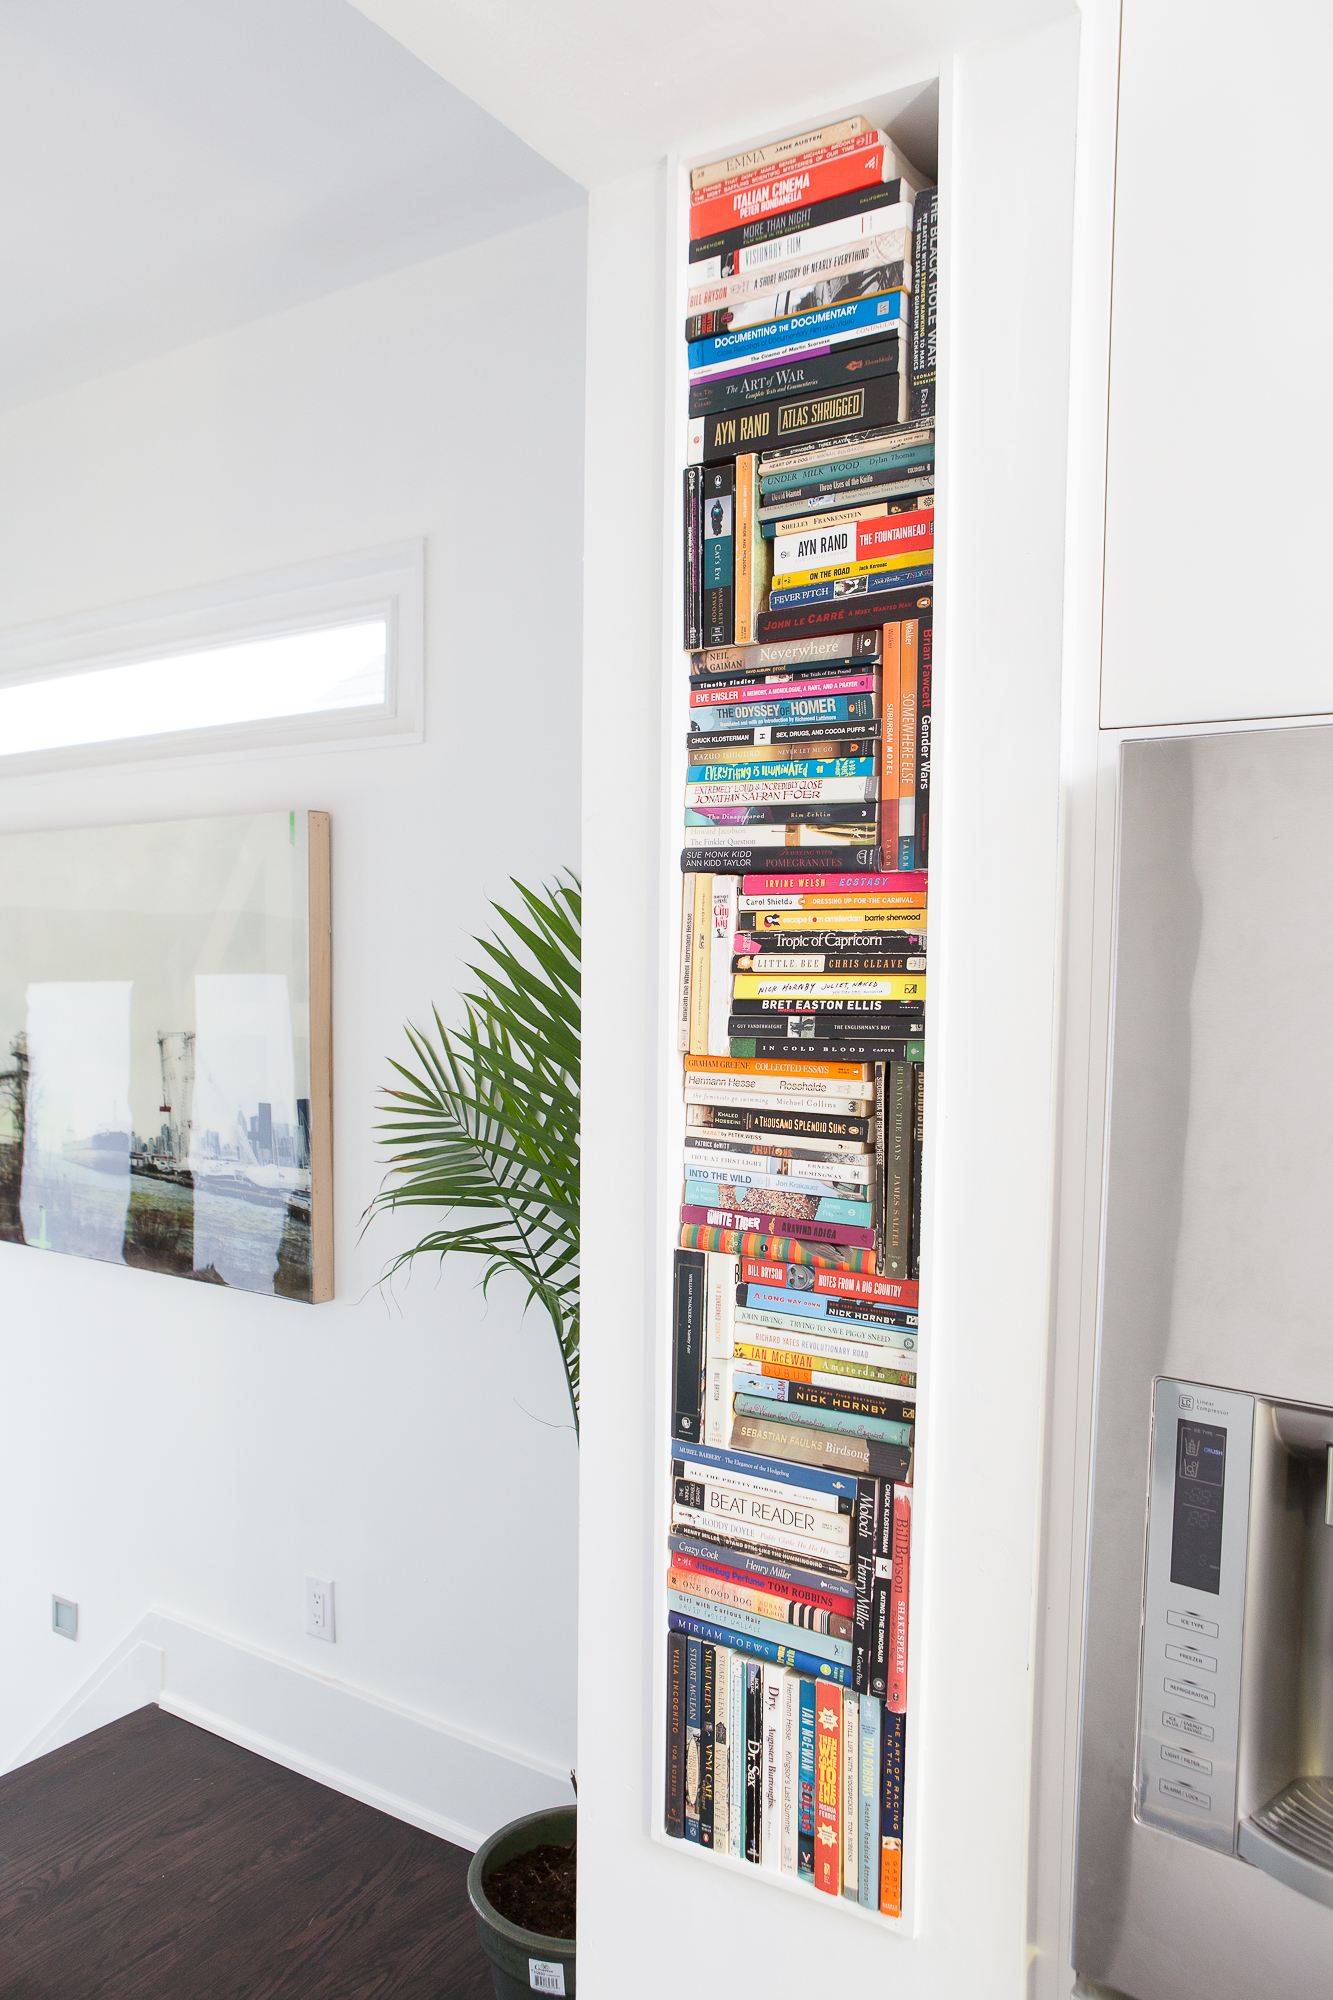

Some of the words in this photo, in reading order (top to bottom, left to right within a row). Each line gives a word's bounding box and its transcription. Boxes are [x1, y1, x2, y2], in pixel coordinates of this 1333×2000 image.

[726, 150, 765, 172] EMMA
[774, 144, 795, 153] JANE
[795, 135, 822, 147] AUSTEN
[733, 186, 770, 211] ITALIAN
[772, 173, 810, 196] CINEMA
[740, 207, 759, 219] PETER
[761, 190, 802, 213] BONDANELLA
[743, 221, 765, 239] MORE
[767, 215, 786, 230] THAN
[788, 208, 812, 224] NIGHT
[689, 294, 702, 308] BILL
[704, 287, 727, 304] BRYSON
[754, 279, 758, 288] A
[760, 275, 776, 287] SHORT
[778, 266, 800, 283] HISTORY
[803, 263, 809, 276] OF
[811, 257, 832, 274] NEARLY
[834, 248, 869, 267] EVERYTHING
[714, 325, 777, 348] DOCUMENTING
[779, 323, 788, 331] THE
[791, 305, 858, 329] DOCUMENTARY
[726, 385, 738, 394] The
[740, 377, 766, 393] ART
[766, 375, 773, 387] of
[776, 369, 804, 386] WAR
[782, 408, 809, 430] ATLAS
[811, 394, 859, 423] SHRUGGED
[714, 418, 737, 447] AYN
[740, 412, 770, 442] RAND
[767, 473, 797, 485] UNDER
[802, 467, 824, 479] MILK
[830, 461, 859, 474] WOOD
[869, 456, 888, 466] Dylan
[891, 451, 915, 461] Thomas
[781, 521, 808, 531] SHELLEY
[813, 511, 862, 525] FRANKENSTEIN
[798, 539, 817, 558] AYN
[820, 533, 848, 553] RAND
[860, 534, 872, 547] THE
[874, 523, 926, 542] FOUNTAINHEAD
[810, 570, 819, 580] ON
[820, 569, 832, 578] THE
[834, 566, 850, 576] ROAD
[773, 592, 800, 605] FEVER
[764, 619, 793, 630] JOHN
[808, 610, 844, 624] CARRÉ
[760, 641, 839, 662] Neverwhere
[923, 628, 932, 660] Brian
[710, 652, 729, 661] NEIL
[710, 660, 742, 671] GAIMAN
[923, 664, 932, 708] Fawcett
[696, 694, 709, 703] EVE
[711, 691, 738, 701] ENSLER
[717, 708, 733, 719] THE
[735, 704, 780, 718] ODYSSEY
[780, 707, 790, 716] OF
[791, 698, 836, 716] HOMER
[902, 693, 915, 759] SOMEWHERE
[921, 715, 931, 757] Gender
[901, 761, 913, 784] ELSE
[920, 759, 931, 790] Wars
[765, 879, 794, 888] IRVINE
[799, 879, 826, 887] WELSH
[839, 878, 889, 886] ECSTASY
[774, 934, 809, 948] Tropic
[811, 935, 822, 946] of
[825, 933, 882, 947] Capricorn
[762, 1000, 792, 1009] BRET
[796, 1000, 844, 1010] EASTON
[847, 1001, 882, 1010] ELLIS
[688, 1059, 721, 1068] GRAHAM
[723, 1060, 751, 1070] GREENE
[755, 1063, 801, 1072] COLLECTED
[803, 1065, 829, 1074] ESSAYS
[754, 1116, 759, 1124] A
[759, 1117, 792, 1130] THOUSAND
[794, 1120, 827, 1132] SPLENDID
[829, 1123, 846, 1134] SUNS
[689, 1170, 711, 1179] INTO
[713, 1171, 727, 1181] THE
[729, 1173, 752, 1184] WILD
[706, 1209, 733, 1225] WHITE
[734, 1214, 761, 1230] TIGER
[747, 1265, 759, 1276] BILL
[761, 1267, 783, 1280] BRYSON
[818, 1275, 836, 1287] NOTES
[838, 1277, 854, 1290] FROM
[856, 1280, 860, 1292] A
[862, 1281, 872, 1293] BIG
[874, 1282, 902, 1298] COUNTRY
[829, 1308, 851, 1317] NICK
[854, 1312, 896, 1324] HORNBY
[751, 1348, 769, 1360] IAN
[772, 1351, 813, 1367] McEWAN
[822, 1357, 886, 1379] Amsterdam
[796, 1392, 826, 1404] NICK
[832, 1401, 886, 1414] HORNBY
[1196, 1399, 1214, 1407] Linear
[1196, 1405, 1229, 1416] Compressor
[741, 1427, 787, 1444] SEBASTIAN
[789, 1436, 823, 1450] FAULKS
[826, 1442, 869, 1461] Birdsong
[1203, 1447, 1223, 1455] CRUSH
[711, 1492, 747, 1514] BEAT
[751, 1501, 814, 1531] READER
[858, 1492, 873, 1538] Moloch
[679, 1542, 700, 1558] Crazy
[701, 1548, 718, 1560] Cock
[745, 1560, 768, 1575] Henry
[769, 1566, 791, 1580] Miller
[856, 1555, 871, 1592] Henry
[768, 1581, 790, 1594] TOM
[792, 1586, 833, 1607] ROBBINS
[856, 1593, 871, 1630] Miller
[679, 1620, 722, 1640] MIRIAM
[729, 1635, 769, 1655] TOEWS
[896, 1601, 905, 1673] SHAKESPEARE
[1180, 1653, 1203, 1663] FREEZER
[765, 1686, 779, 1710] Dry.
[1170, 1684, 1209, 1700] REFRIGERATOR
[802, 1706, 814, 1726] IAN
[747, 1740, 759, 1759] Dr.
[818, 1742, 837, 1756] WE
[819, 1734, 837, 1748] THEN
[862, 1736, 874, 1755] TOM
[888, 1735, 892, 1746] IN
[818, 1756, 836, 1768] CAME
[747, 1761, 759, 1787] Sax
[819, 1763, 836, 1784] TO
[862, 1756, 874, 1798] ROBBINS
[894, 1767, 899, 1781] OF
[819, 1780, 836, 1796] THE
[801, 1782, 813, 1831] SOLAR
[819, 1794, 836, 1806] END
